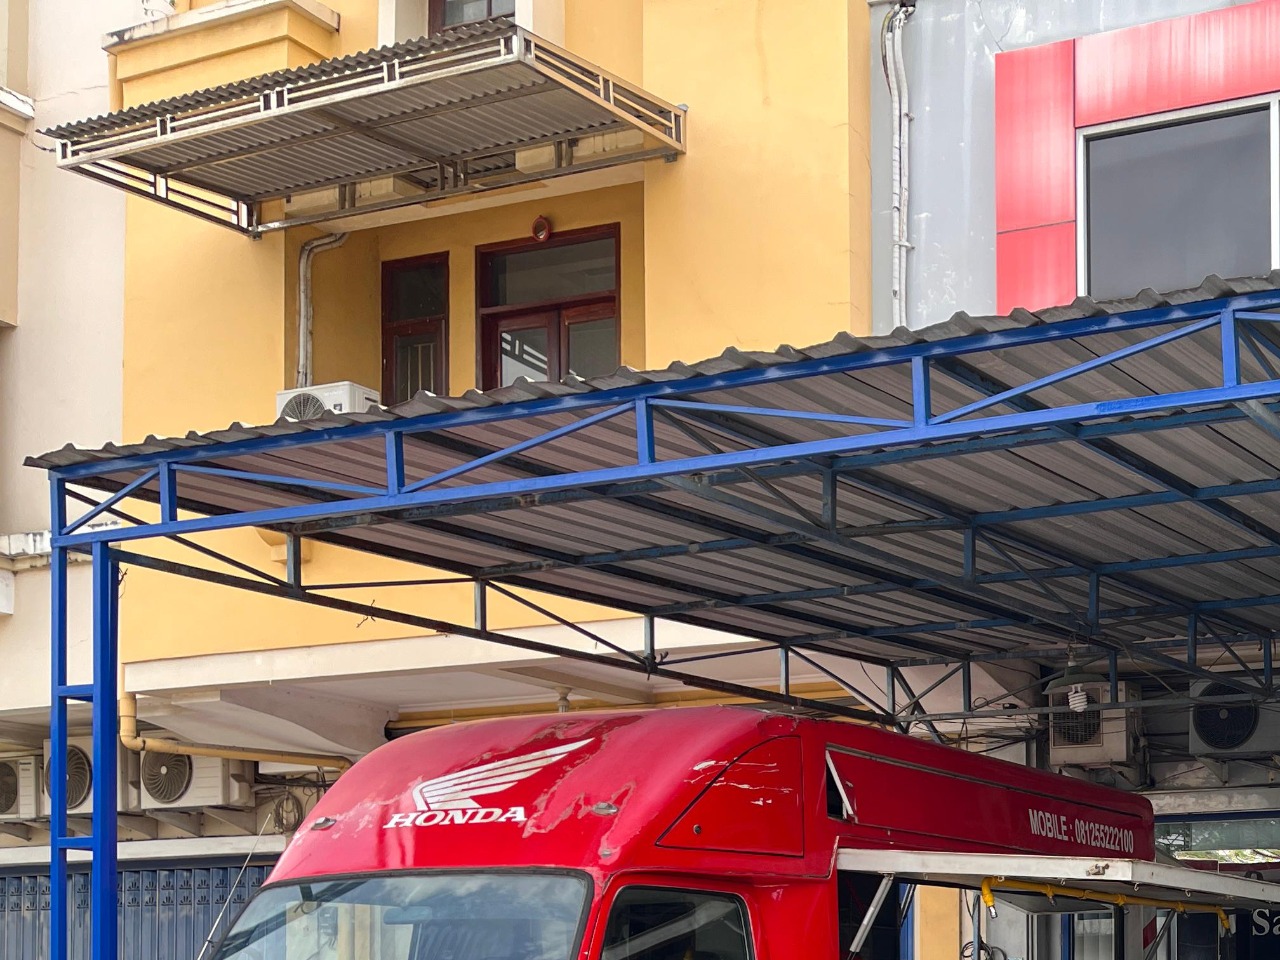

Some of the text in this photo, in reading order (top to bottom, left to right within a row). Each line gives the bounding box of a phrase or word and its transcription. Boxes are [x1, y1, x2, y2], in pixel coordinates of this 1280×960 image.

[383, 806, 528, 829] HONDA
[1028, 808, 1068, 841] MOBILE
[1074, 818, 1134, 854] 081255222100
